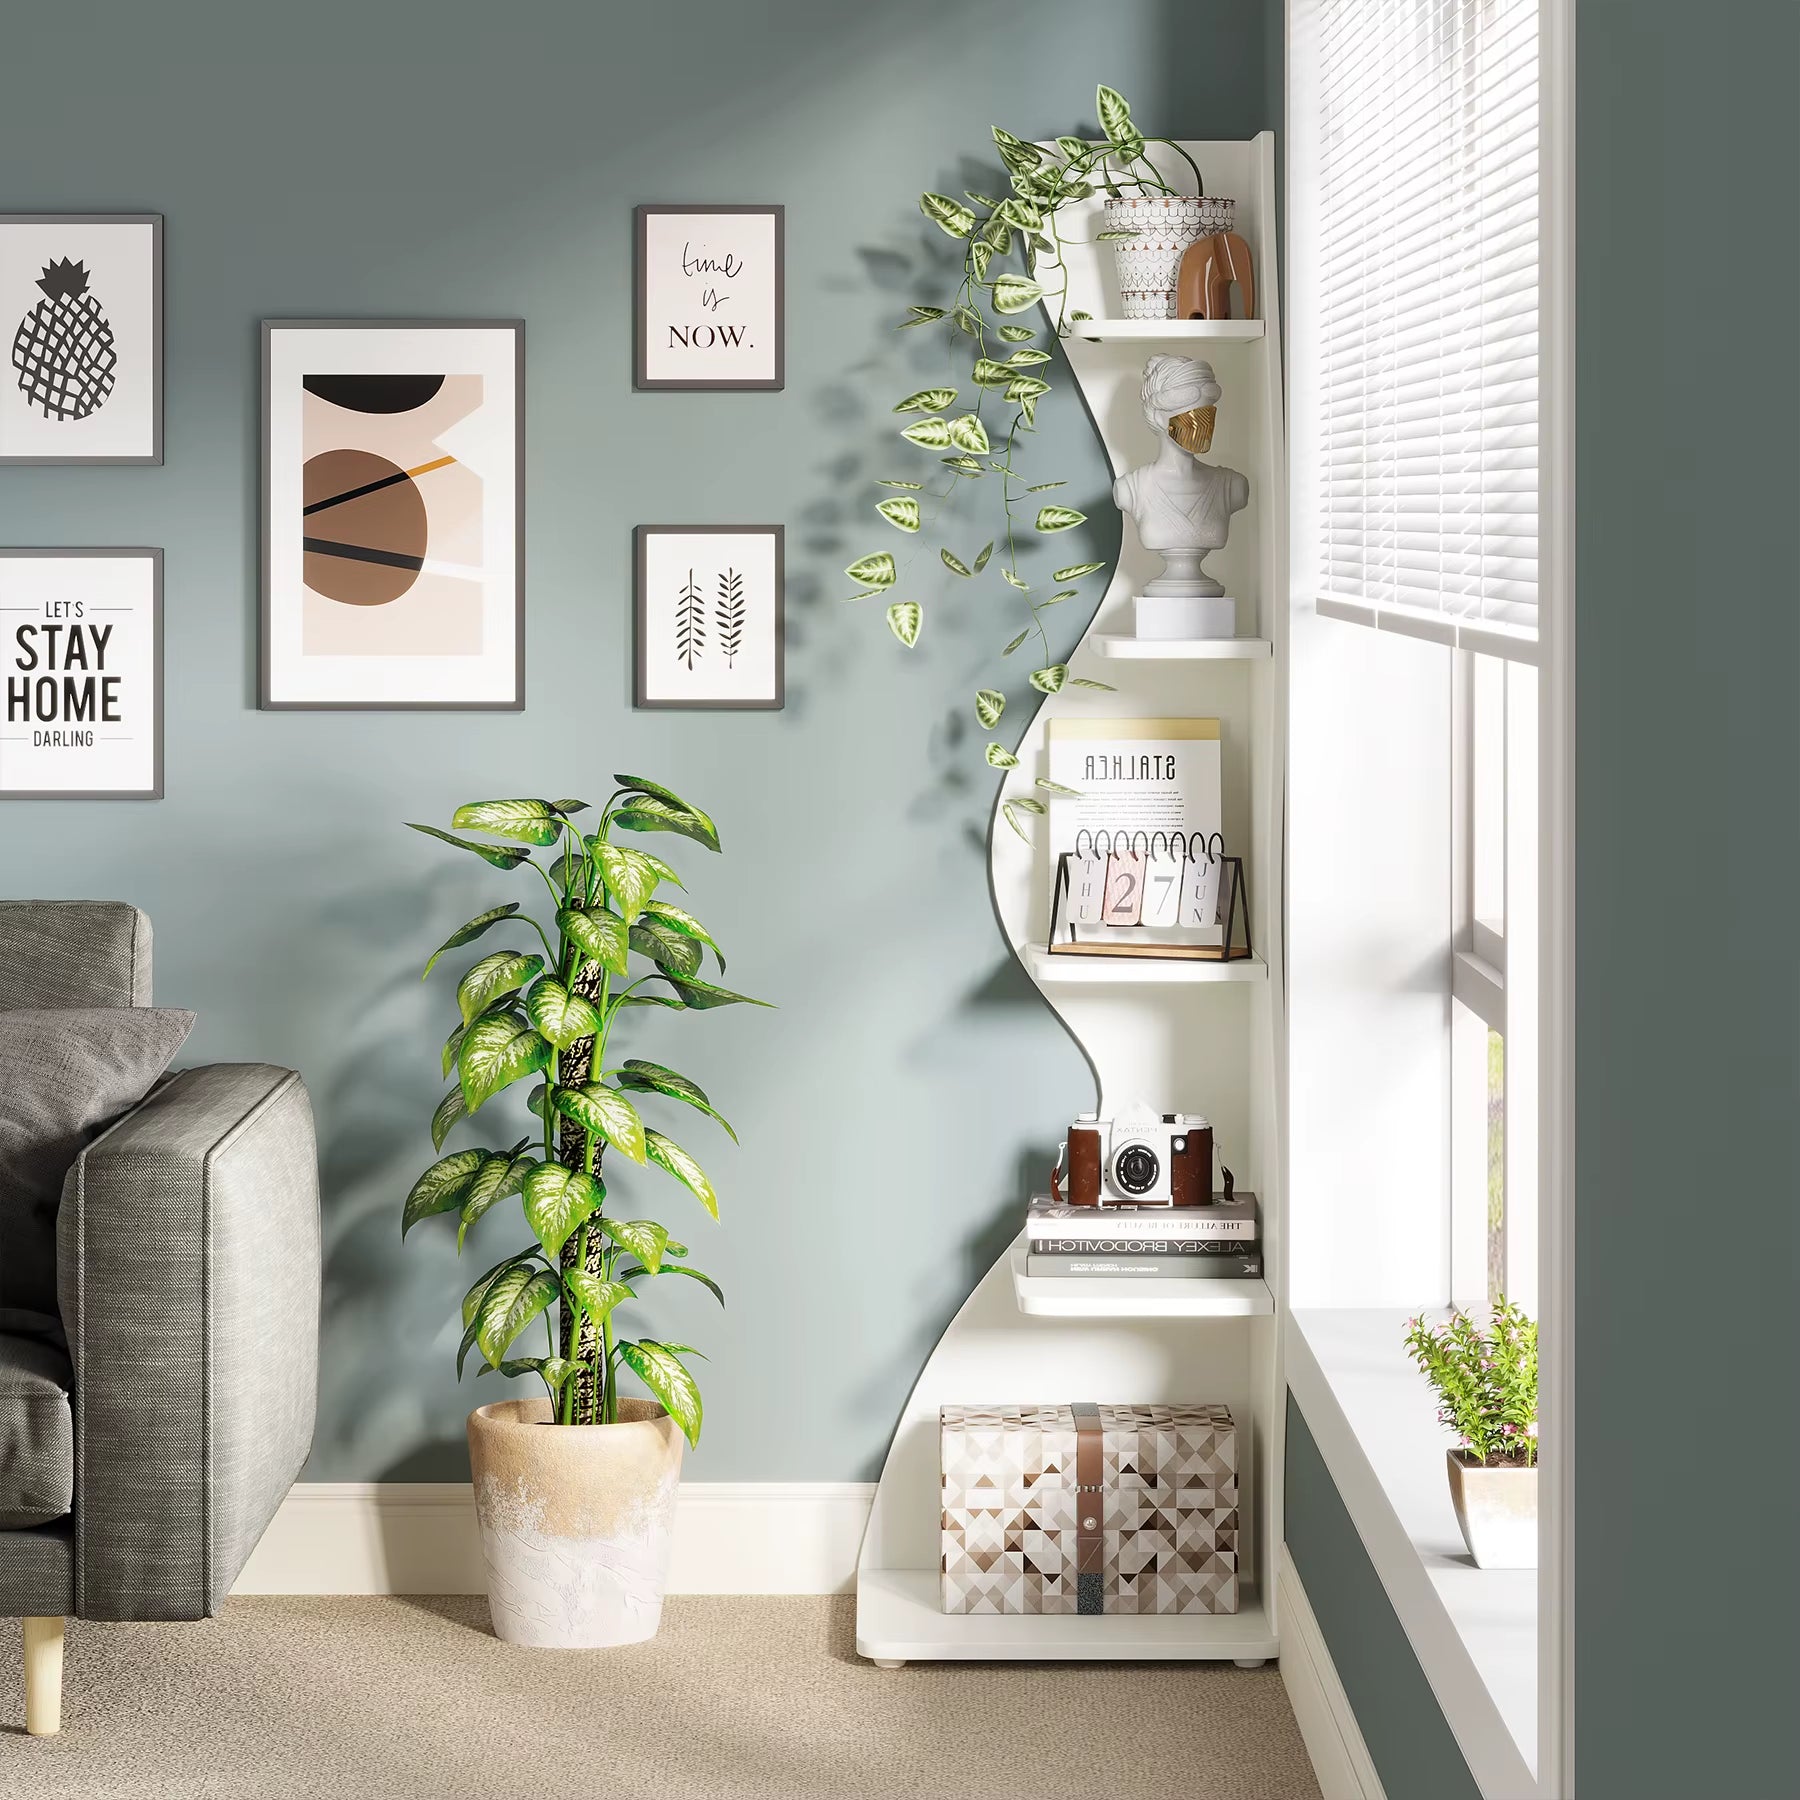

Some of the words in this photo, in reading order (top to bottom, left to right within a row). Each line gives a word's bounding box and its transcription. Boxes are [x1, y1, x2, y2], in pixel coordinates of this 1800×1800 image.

[682, 242, 743, 278] time
[702, 282, 730, 312] is
[667, 325, 754, 348] NOW.
[45, 601, 84, 618] LET'S
[15, 624, 114, 671] STAY
[7, 676, 122, 722] HOME
[33, 730, 94, 747] DARLING
